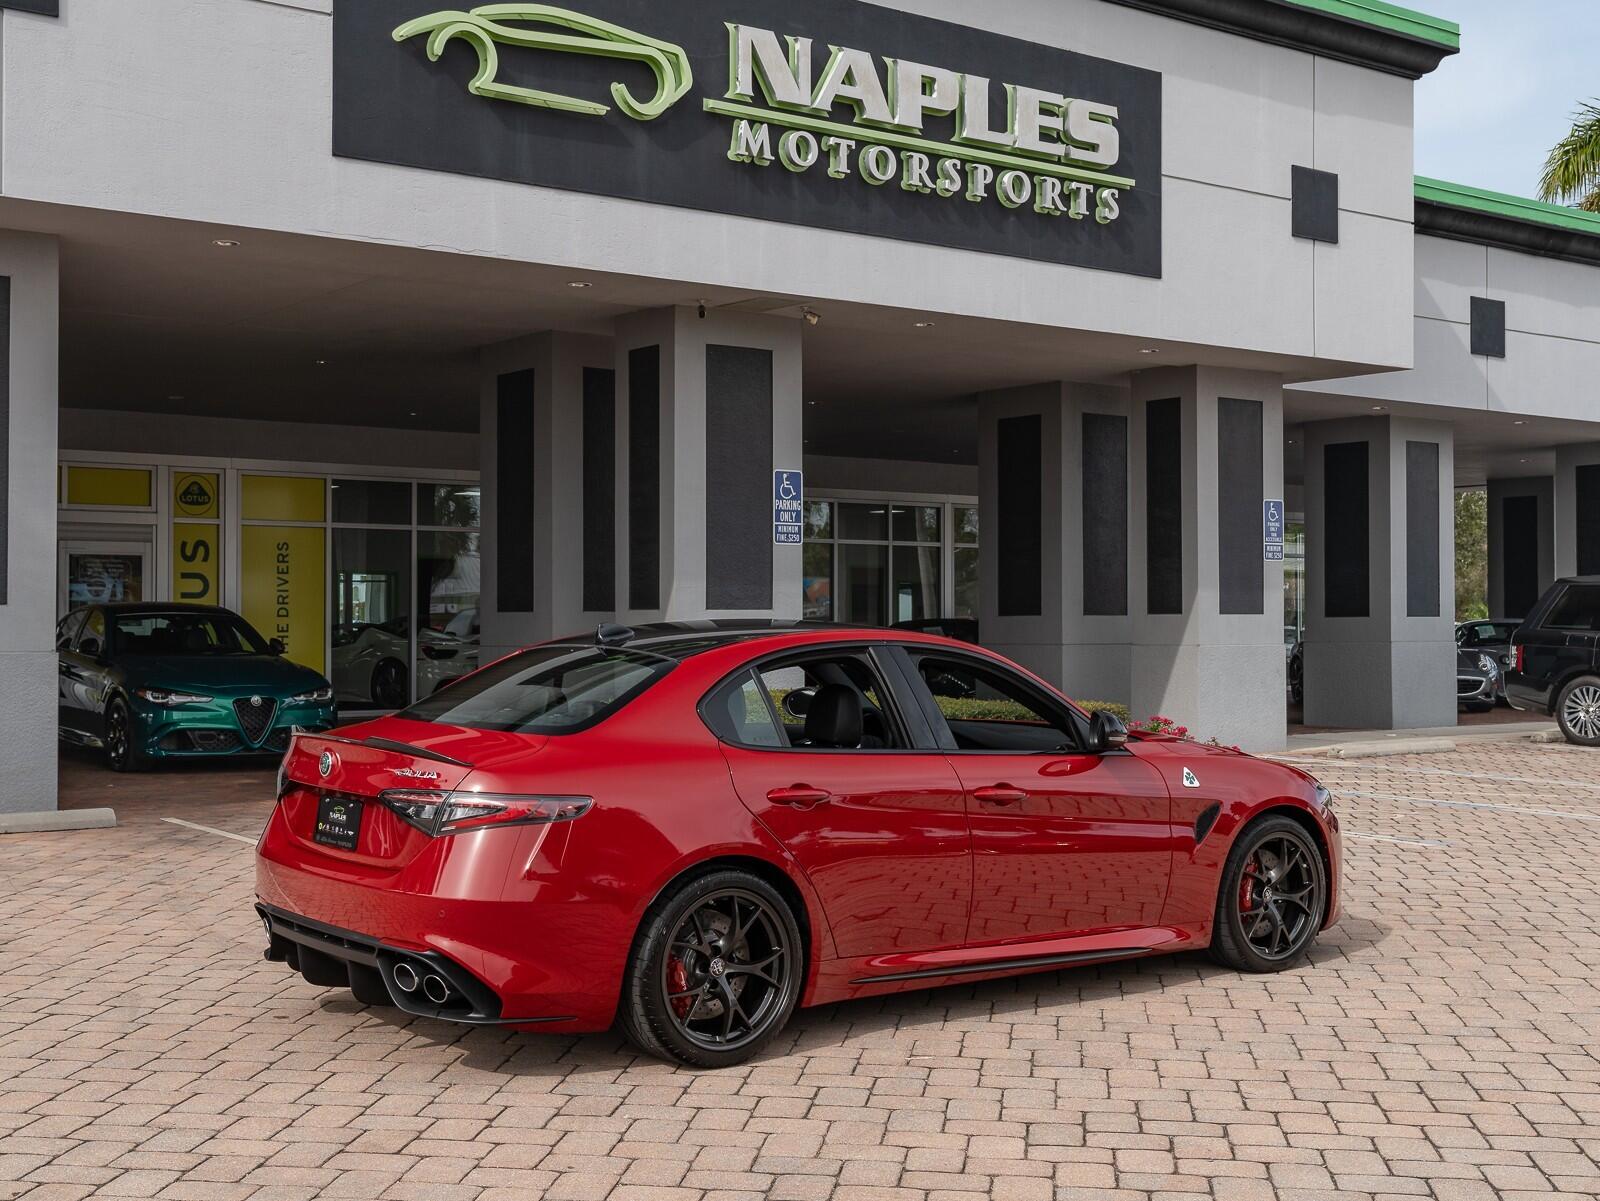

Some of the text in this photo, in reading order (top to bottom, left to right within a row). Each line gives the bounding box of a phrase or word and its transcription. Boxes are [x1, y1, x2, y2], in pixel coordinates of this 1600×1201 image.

[723, 22, 1120, 170] NAPLES
[727, 119, 1120, 224] MOTORSPORTS
[776, 500, 801, 510] PARKING
[780, 512, 796, 522] ONLY
[277, 541, 290, 618] DRIVERS
